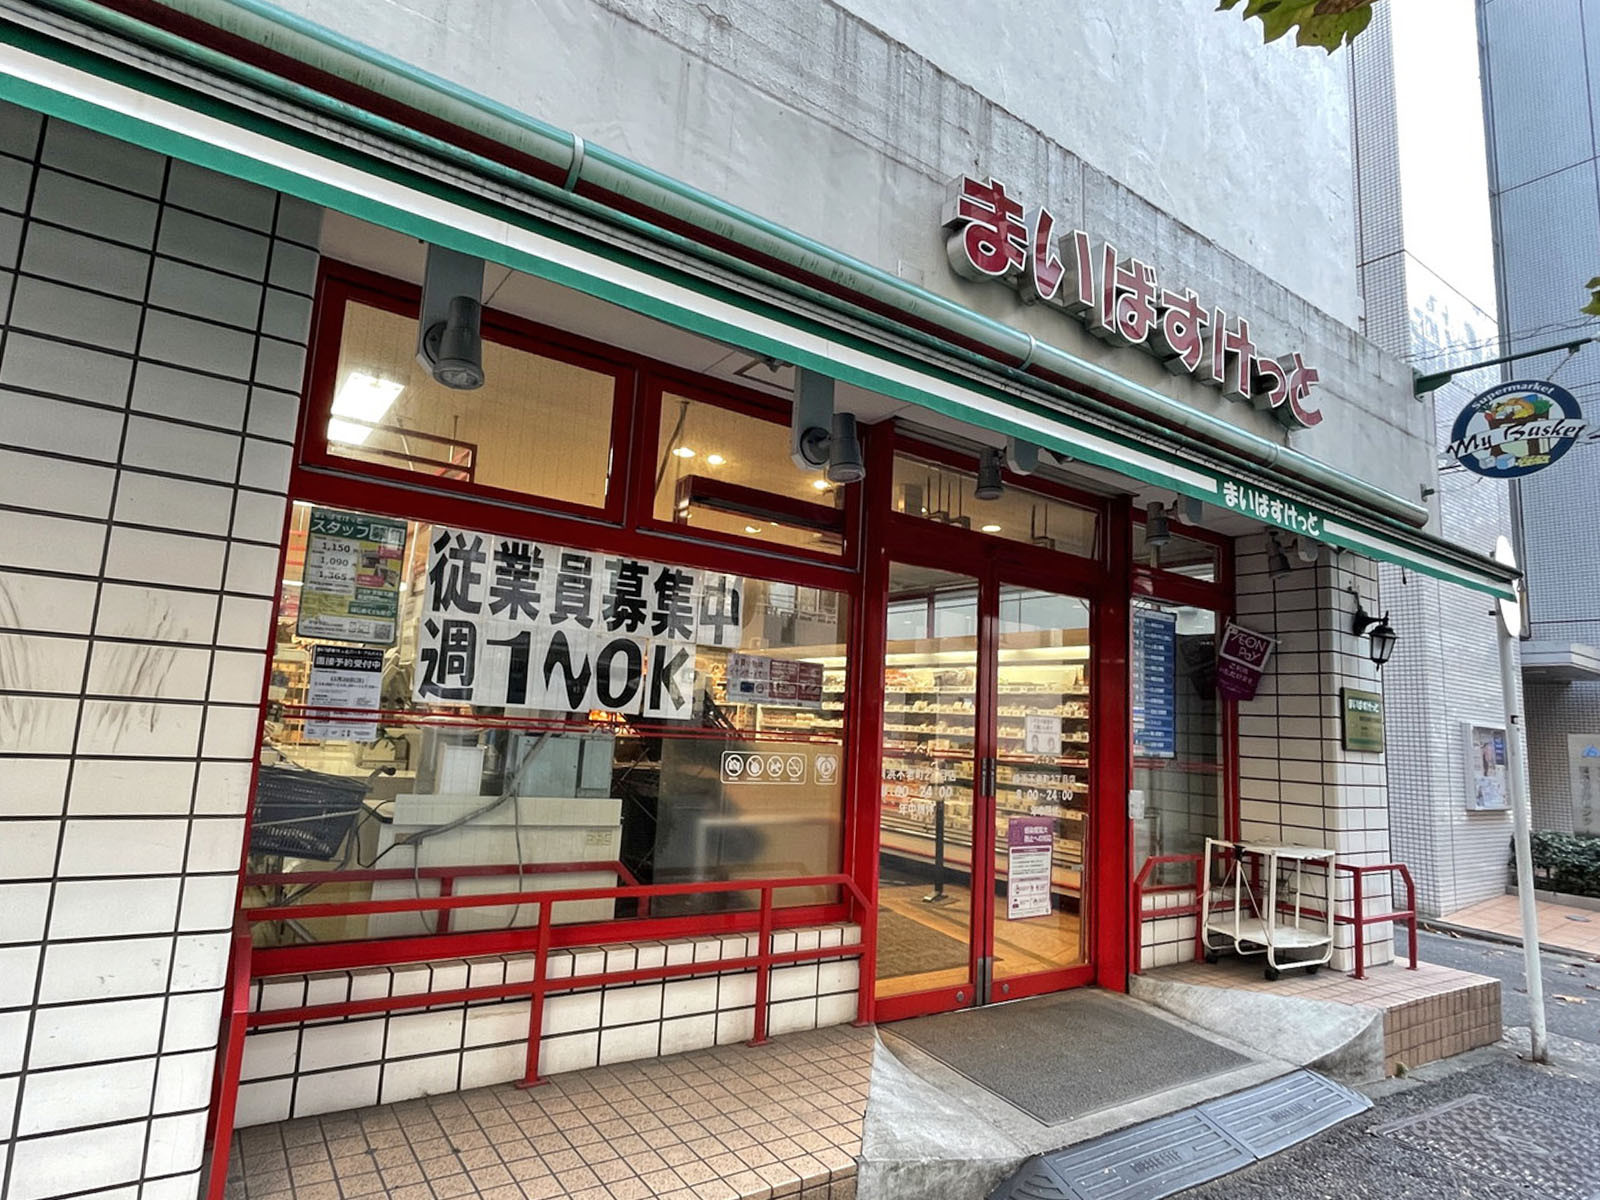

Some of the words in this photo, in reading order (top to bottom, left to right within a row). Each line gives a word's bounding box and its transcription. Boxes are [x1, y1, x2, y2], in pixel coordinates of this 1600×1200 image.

[957, 175, 1323, 427] まいばすけっと
[1471, 382, 1556, 409] Supermarket
[1446, 433, 1493, 459] My
[1504, 419, 1588, 441] Basket
[1223, 481, 1320, 536] まいばすけっと
[428, 530, 740, 645] 従業員募集中
